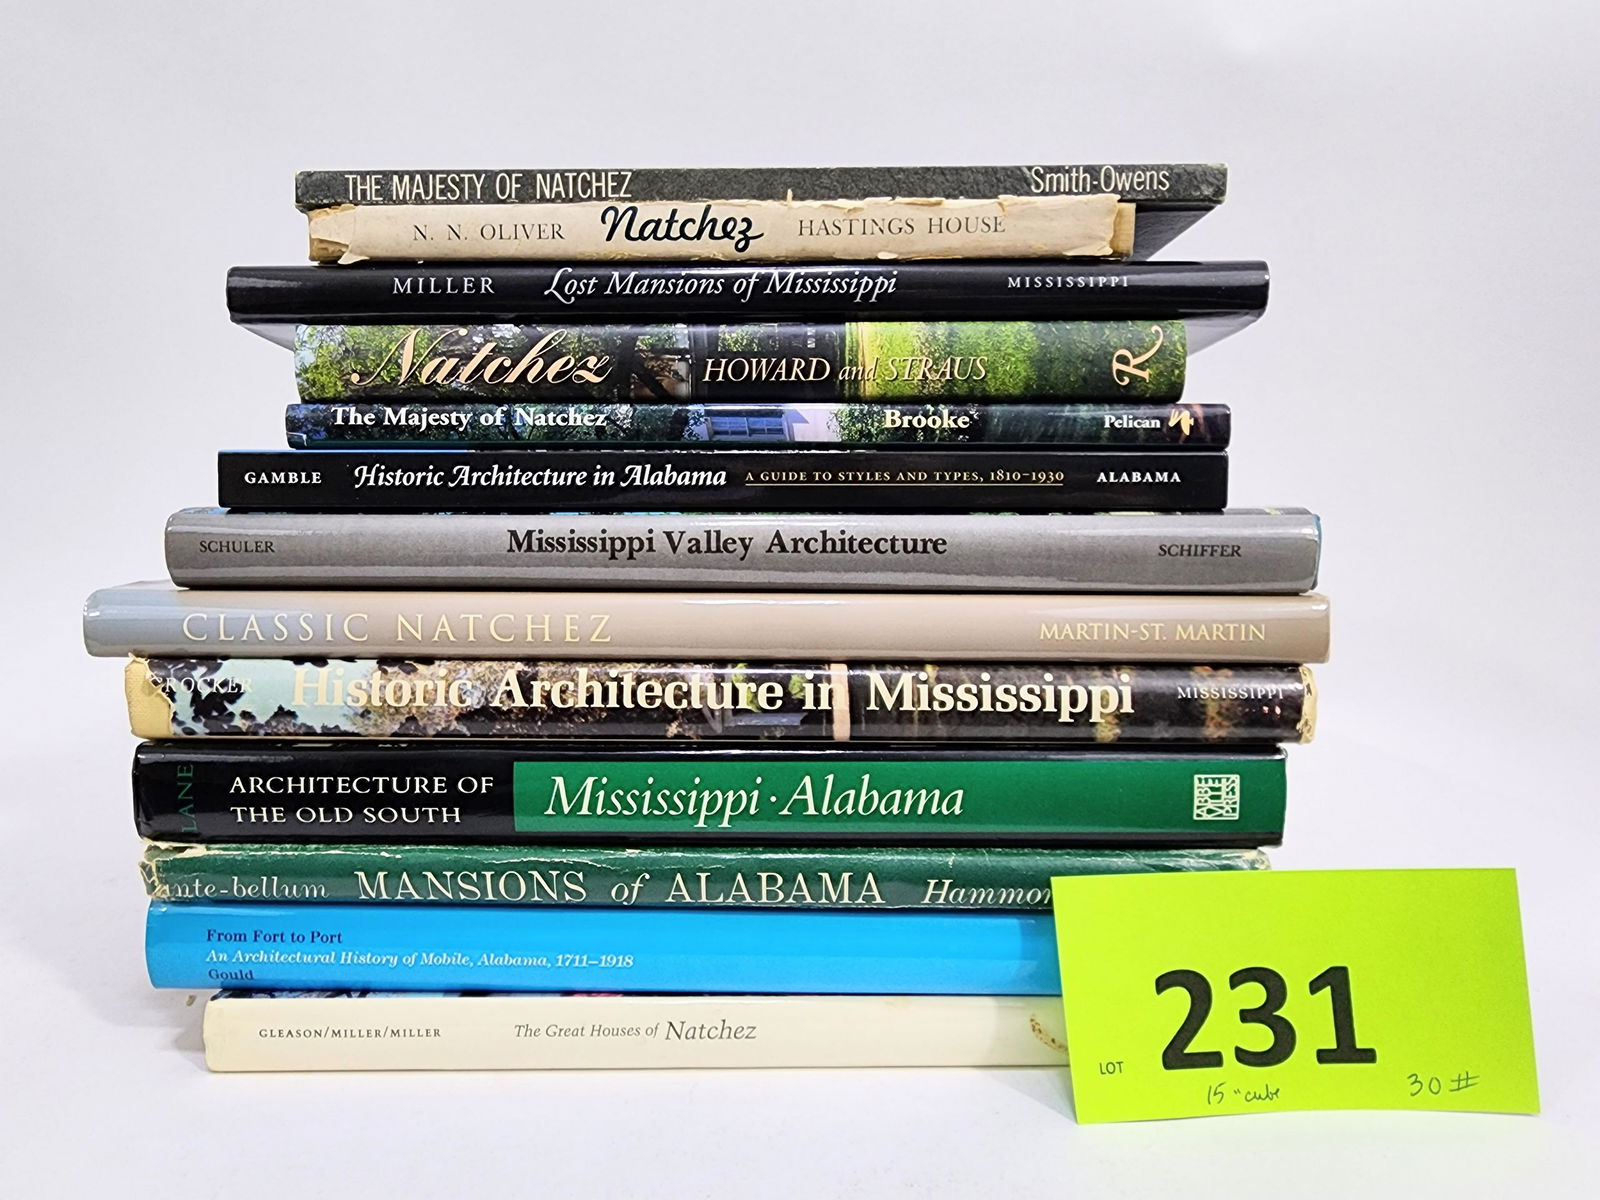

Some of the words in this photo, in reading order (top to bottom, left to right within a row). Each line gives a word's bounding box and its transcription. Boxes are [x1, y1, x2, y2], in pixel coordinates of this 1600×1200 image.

[345, 173, 381, 201] THE
[391, 173, 486, 200] MAJESTY
[496, 173, 523, 199] OF
[535, 172, 632, 199] NATCHEZ
[1030, 165, 1170, 195] Smith-Owens
[413, 224, 434, 241] N.
[446, 224, 468, 241] N.
[480, 222, 565, 241] OLIVER
[600, 204, 764, 253] Natchez
[798, 217, 915, 237] HASTINGS
[928, 215, 1006, 235] HOUSE
[392, 276, 496, 295] MILLER
[544, 267, 597, 304] Lost
[604, 270, 726, 296] Mansions
[732, 272, 760, 303] of
[763, 269, 898, 303] Mississippi
[1007, 275, 1129, 289] MISSISSIPPI
[349, 326, 614, 387] Natchez
[702, 357, 831, 382] HOWARD
[838, 357, 880, 381] and
[884, 355, 988, 381] STRAUS
[331, 405, 376, 427] The
[383, 407, 474, 432] Majesty
[479, 406, 506, 427] of
[515, 407, 607, 428] Natchez
[884, 408, 970, 430] Brooke
[1104, 413, 1161, 430] Pelican
[244, 471, 322, 484] GAMBLE
[353, 464, 444, 490] Historic
[447, 465, 588, 489] Architecture
[593, 466, 616, 487] in
[618, 465, 727, 487] Alabama
[745, 471, 755, 481] A
[759, 471, 807, 482] GUIDE
[811, 471, 833, 482] TO
[837, 471, 892, 482] STYLES
[896, 471, 928, 482] AND
[933, 471, 985, 485] TYPES,
[1096, 471, 1182, 483] ALABAMA
[199, 539, 275, 554] SCHULER
[506, 528, 656, 560] Mississippi
[663, 529, 753, 561] Valley
[766, 529, 948, 555] Architecture
[1158, 542, 1242, 558] SCHIFFER
[182, 613, 371, 642] CLASSIC
[395, 613, 613, 642] NATCHEZ
[1175, 623, 1267, 642] MARTIN
[292, 667, 473, 708] Historic
[490, 672, 784, 711] Architecture
[801, 673, 837, 711] in
[865, 672, 1135, 724] Mississippi
[1177, 686, 1284, 699] MISSISSIPPI
[229, 776, 448, 794] ARCHITECTURE
[457, 776, 494, 794] OF
[176, 764, 198, 832] LANE
[544, 775, 762, 829] Mississippi
[779, 774, 964, 817] Alabama
[230, 806, 287, 824] THE
[295, 806, 353, 824] OLD
[363, 806, 461, 824] SOUTH
[354, 870, 587, 901] MANSIONS
[611, 873, 649, 906] of
[666, 872, 886, 906] ALABAMA
[206, 929, 247, 942] From
[253, 930, 286, 943] Fort
[291, 930, 305, 943] to
[311, 931, 343, 944] Port
[206, 950, 227, 962] An
[232, 950, 336, 964] Architectural
[340, 951, 398, 967] History
[403, 952, 418, 967] of
[421, 952, 474, 968] Mobile,
[478, 953, 550, 969] Alabama,
[208, 969, 255, 981] Gould
[514, 1024, 541, 1038] The
[545, 1024, 585, 1038] Great
[589, 1023, 641, 1038] Houses
[645, 1023, 660, 1038] of
[665, 1019, 757, 1042] Natchez
[1099, 1060, 1123, 1075] LOT
[1155, 965, 1378, 1071] 231
[259, 1026, 441, 1039] GLEASON/MILLER/MILLER
